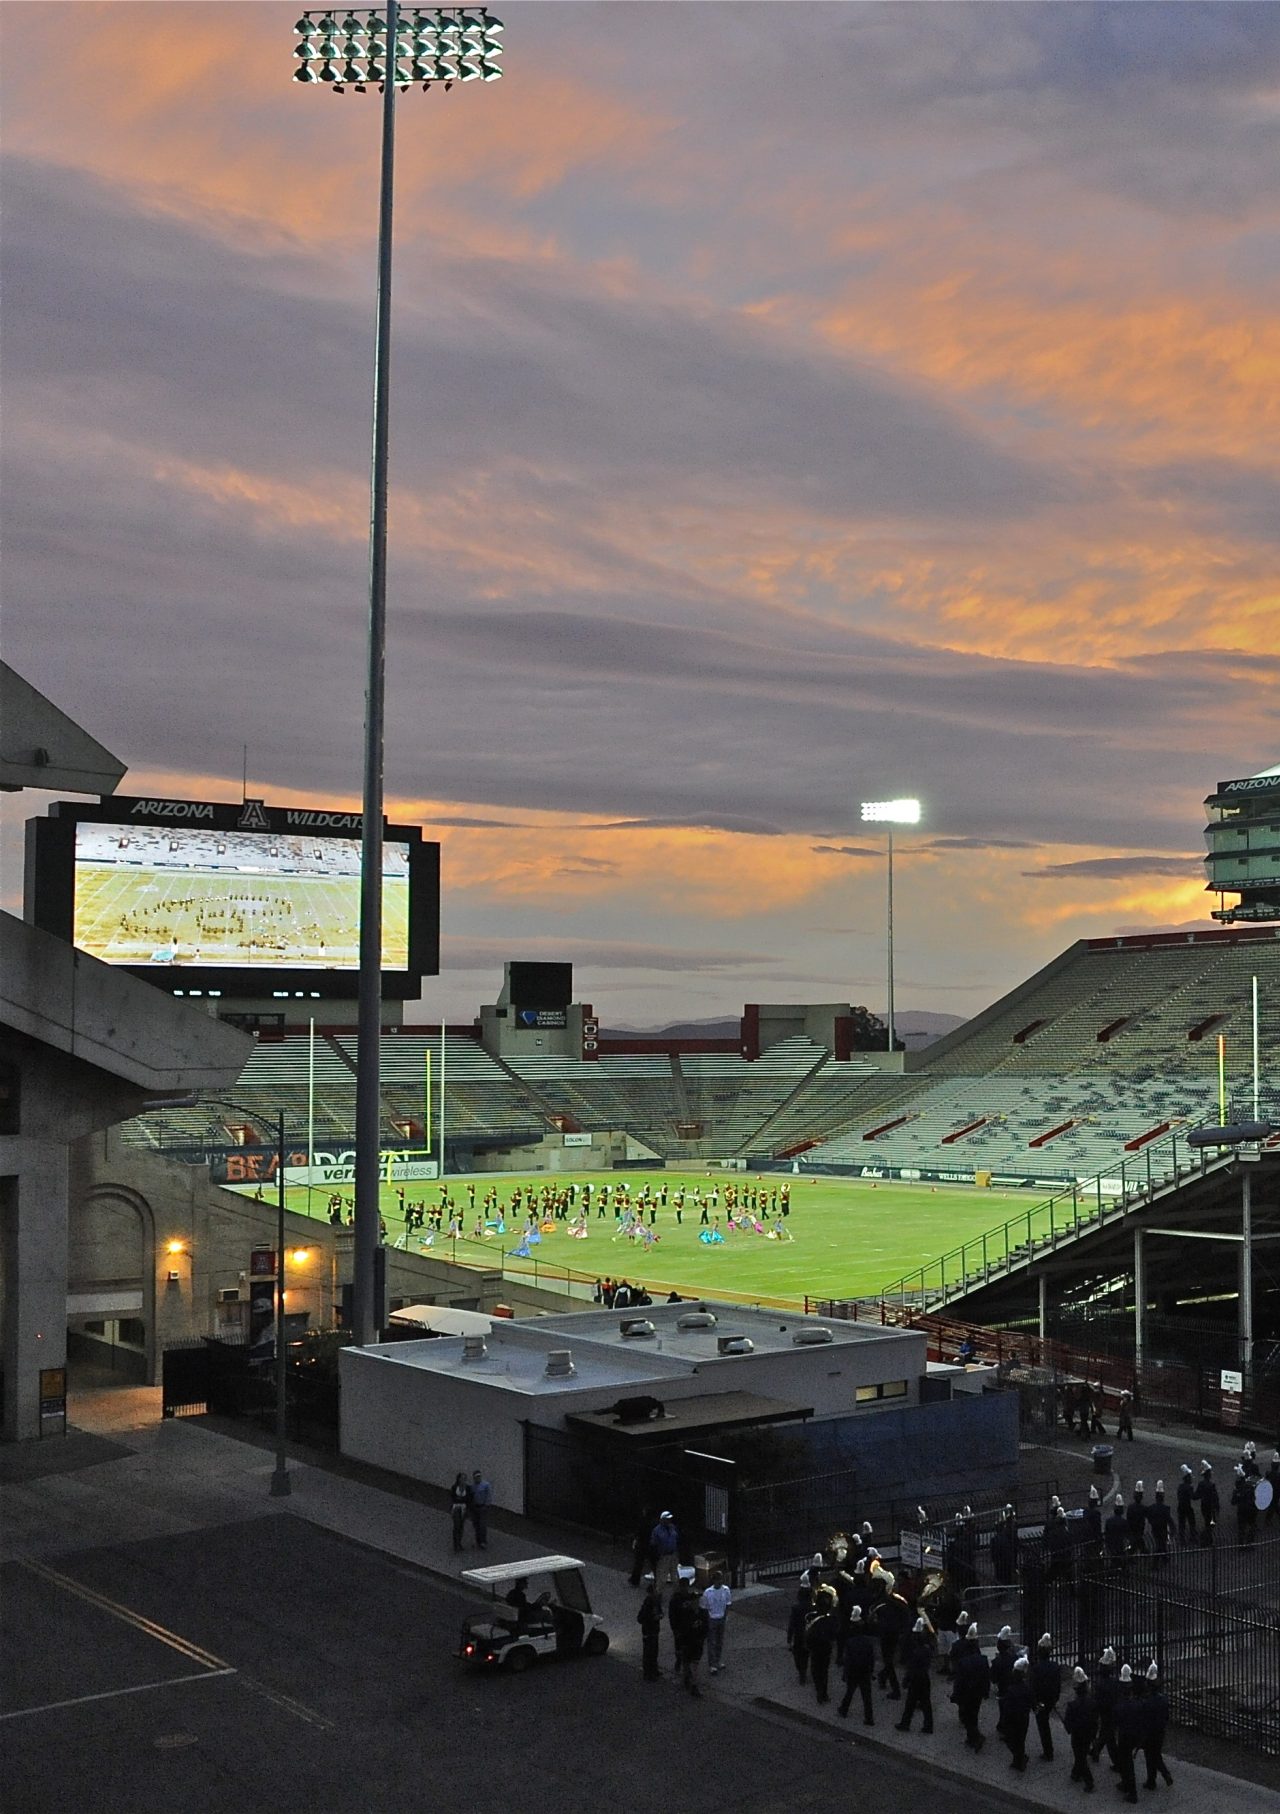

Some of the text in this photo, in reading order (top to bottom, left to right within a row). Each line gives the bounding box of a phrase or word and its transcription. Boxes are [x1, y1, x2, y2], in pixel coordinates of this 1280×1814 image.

[131, 801, 214, 819] ARIZONA
[237, 802, 271, 830] A
[390, 1166, 432, 1178] wireless
